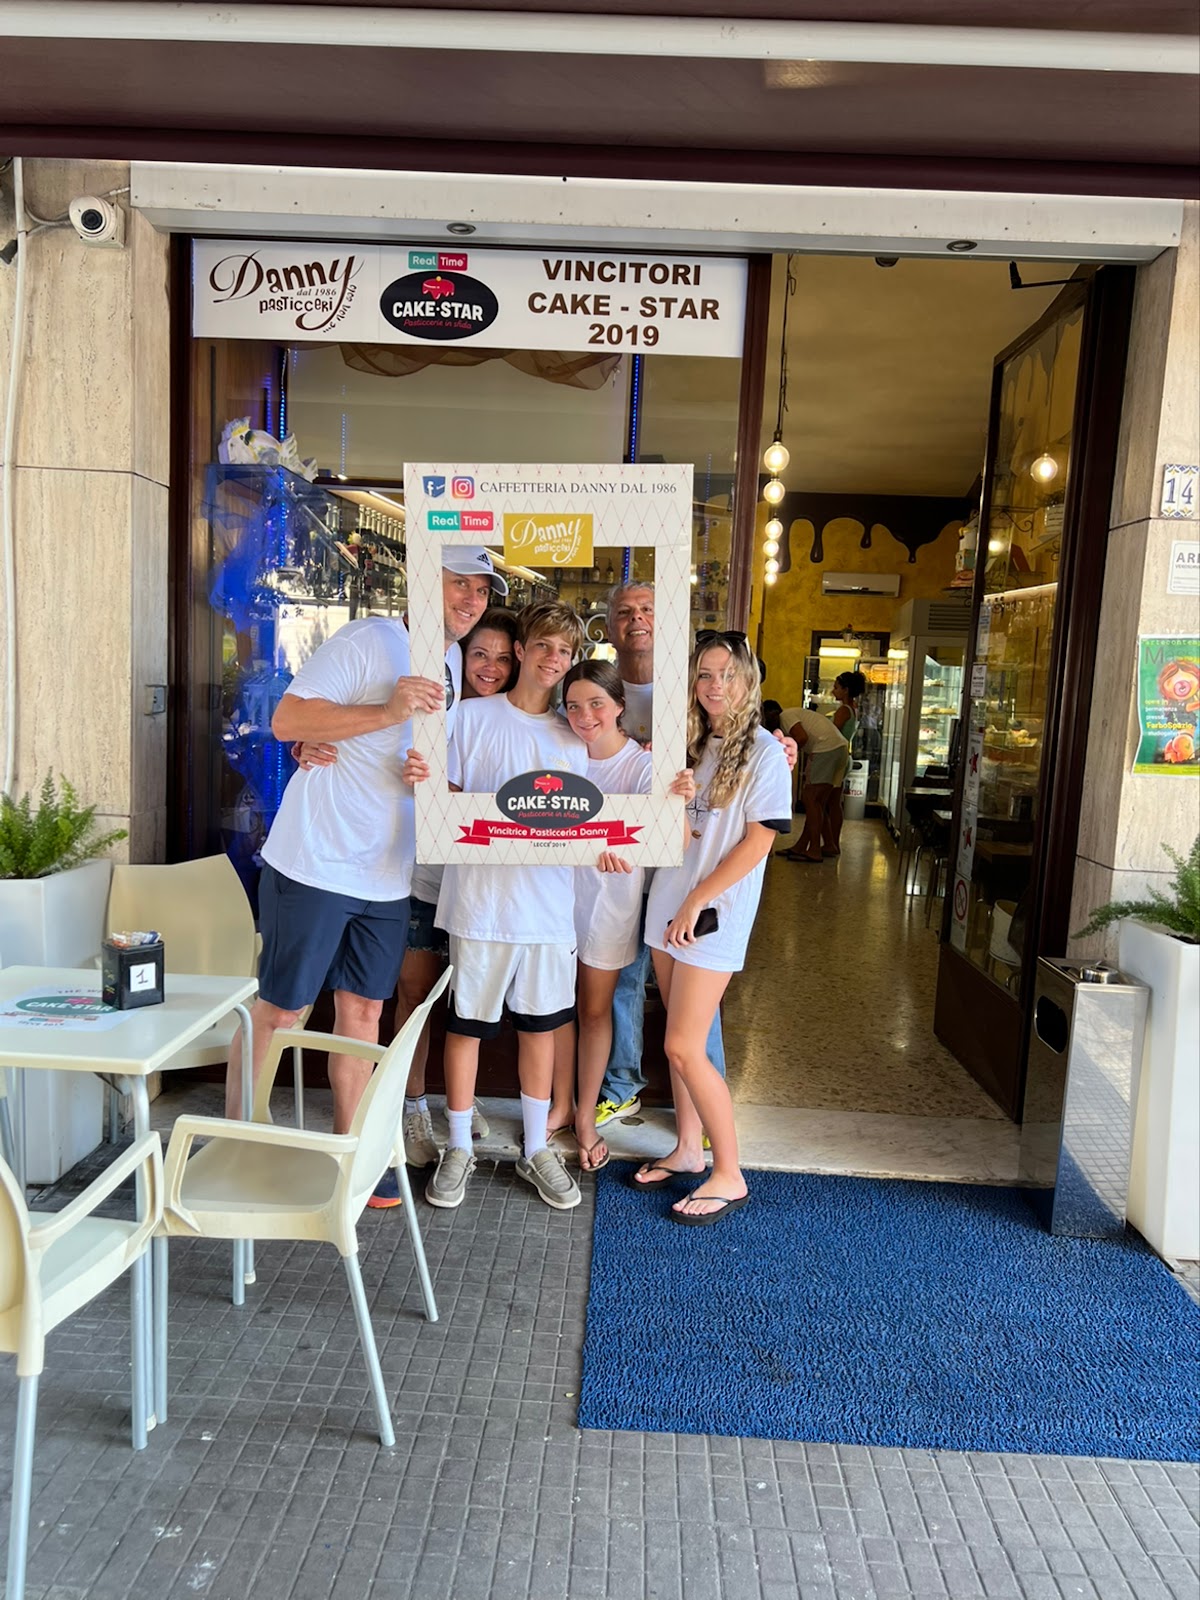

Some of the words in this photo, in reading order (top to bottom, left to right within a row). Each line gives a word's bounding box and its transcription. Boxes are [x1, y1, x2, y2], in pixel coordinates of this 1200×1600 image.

[412, 256, 436, 266] Real
[440, 257, 464, 267] Time
[543, 259, 701, 286] VINCITORI
[209, 250, 365, 331] Danny
[296, 288, 312, 296] dal
[314, 288, 337, 296] 1986
[527, 291, 611, 316] CAKE
[638, 296, 720, 320] STAR
[403, 318, 443, 327] Pasticcerie
[454, 319, 472, 329] sfida
[588, 323, 660, 347] 2019
[480, 482, 567, 494] CAFFETTERIA
[570, 483, 617, 494] DANNY
[620, 483, 647, 494] DAL
[651, 483, 677, 494] 1986
[1165, 478, 1193, 505] 14
[432, 515, 459, 526] Real
[463, 516, 489, 526] Time
[510, 516, 585, 564] Danny
[555, 810, 562, 818] in
[563, 810, 580, 819] sfida
[487, 826, 527, 836] Vincitrice
[530, 827, 577, 837] Pasticceria
[580, 827, 609, 838] Danny
[136, 968, 149, 985] 1
